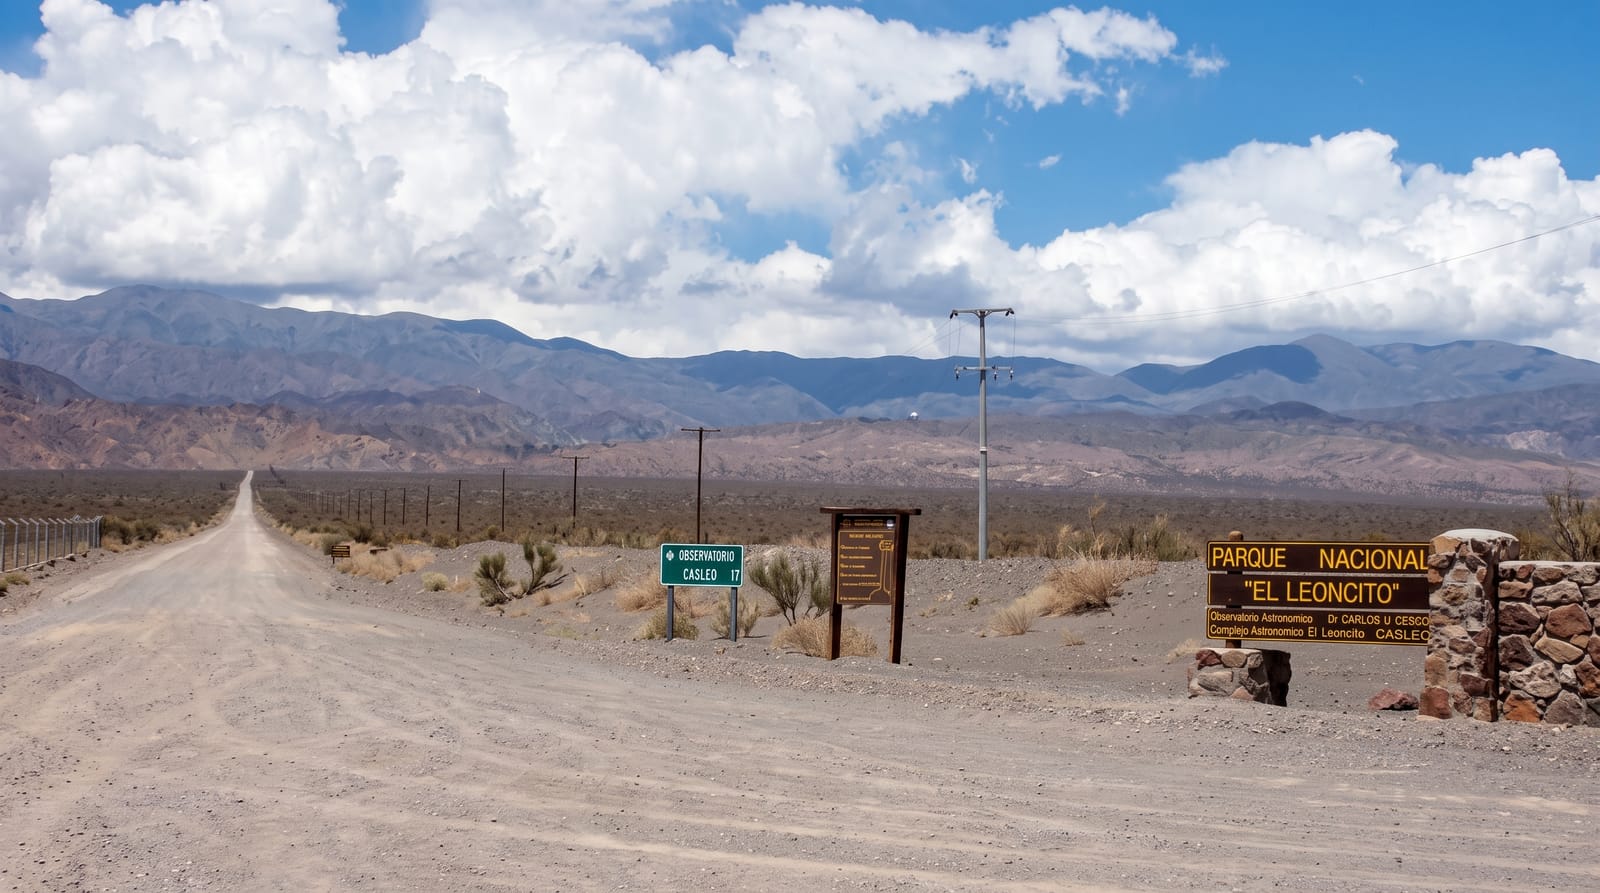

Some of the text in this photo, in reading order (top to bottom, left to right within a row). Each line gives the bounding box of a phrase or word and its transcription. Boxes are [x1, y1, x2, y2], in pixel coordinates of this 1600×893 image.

[679, 549, 735, 562] OBSERVATORIO
[1212, 547, 1429, 570] PARQUE NACIONAL
[683, 568, 740, 581] CASLEO 17
[1244, 580, 1400, 604] "EL LEONCITO"
[1210, 611, 1430, 626] Observatorio Astronomico Dr CARLOS U CESCO
[1210, 624, 1430, 641] Complejo Astronomico El Leoncito CASLEO
